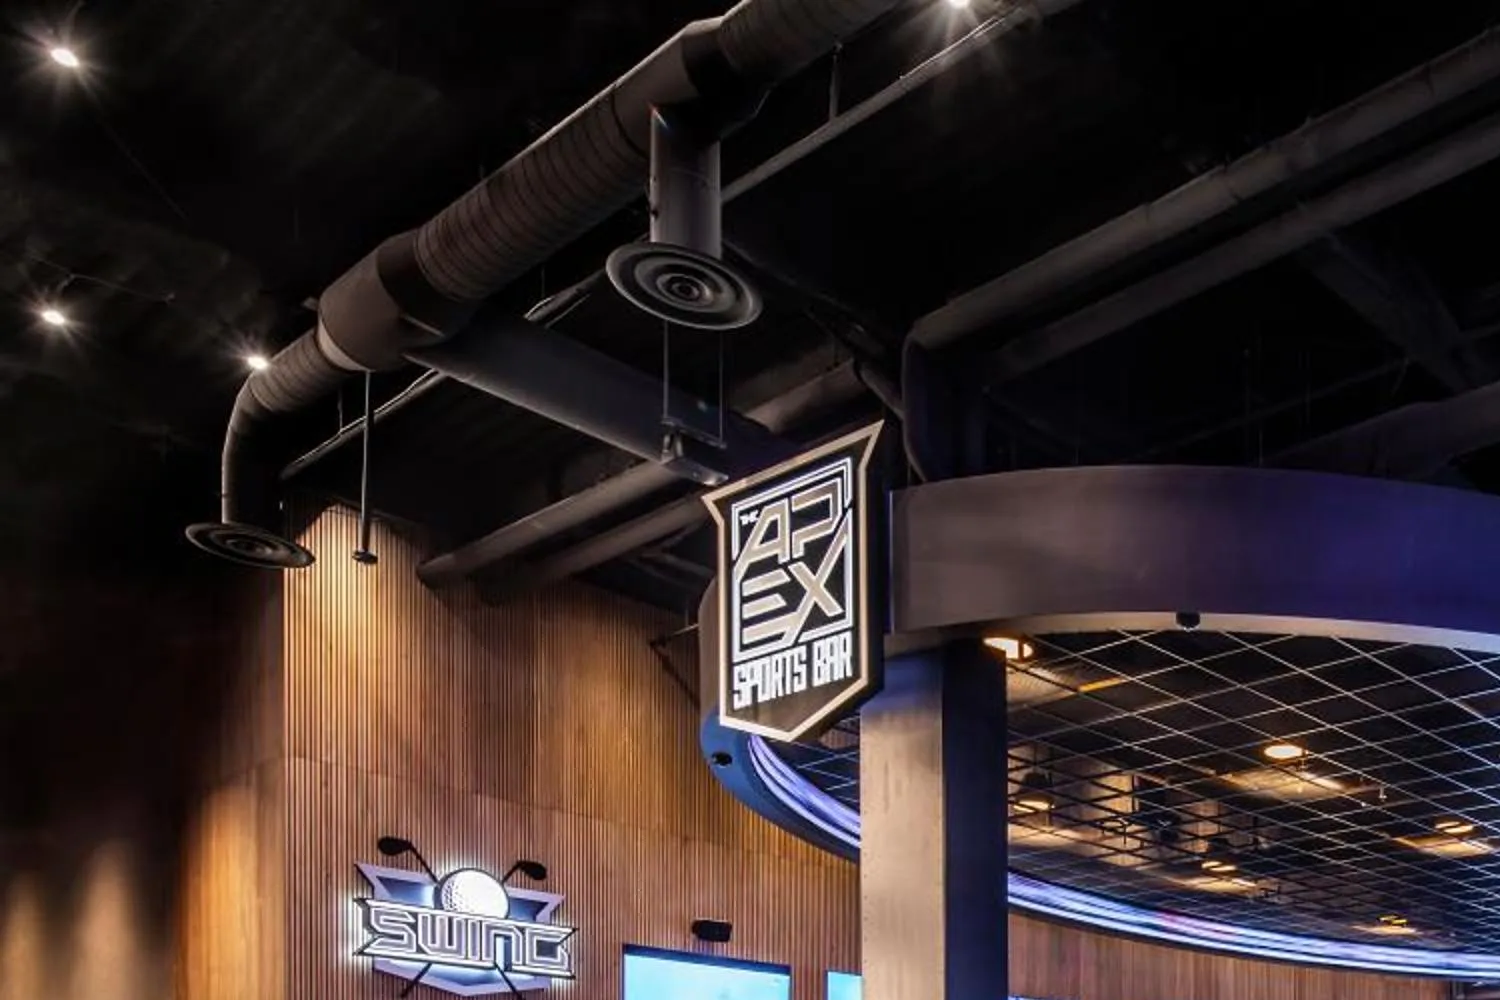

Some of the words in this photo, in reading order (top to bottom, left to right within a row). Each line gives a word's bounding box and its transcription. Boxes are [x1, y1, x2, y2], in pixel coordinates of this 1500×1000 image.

[733, 645, 807, 711] SPORTS
[812, 630, 852, 689] BAR
[366, 905, 574, 972] SWING
